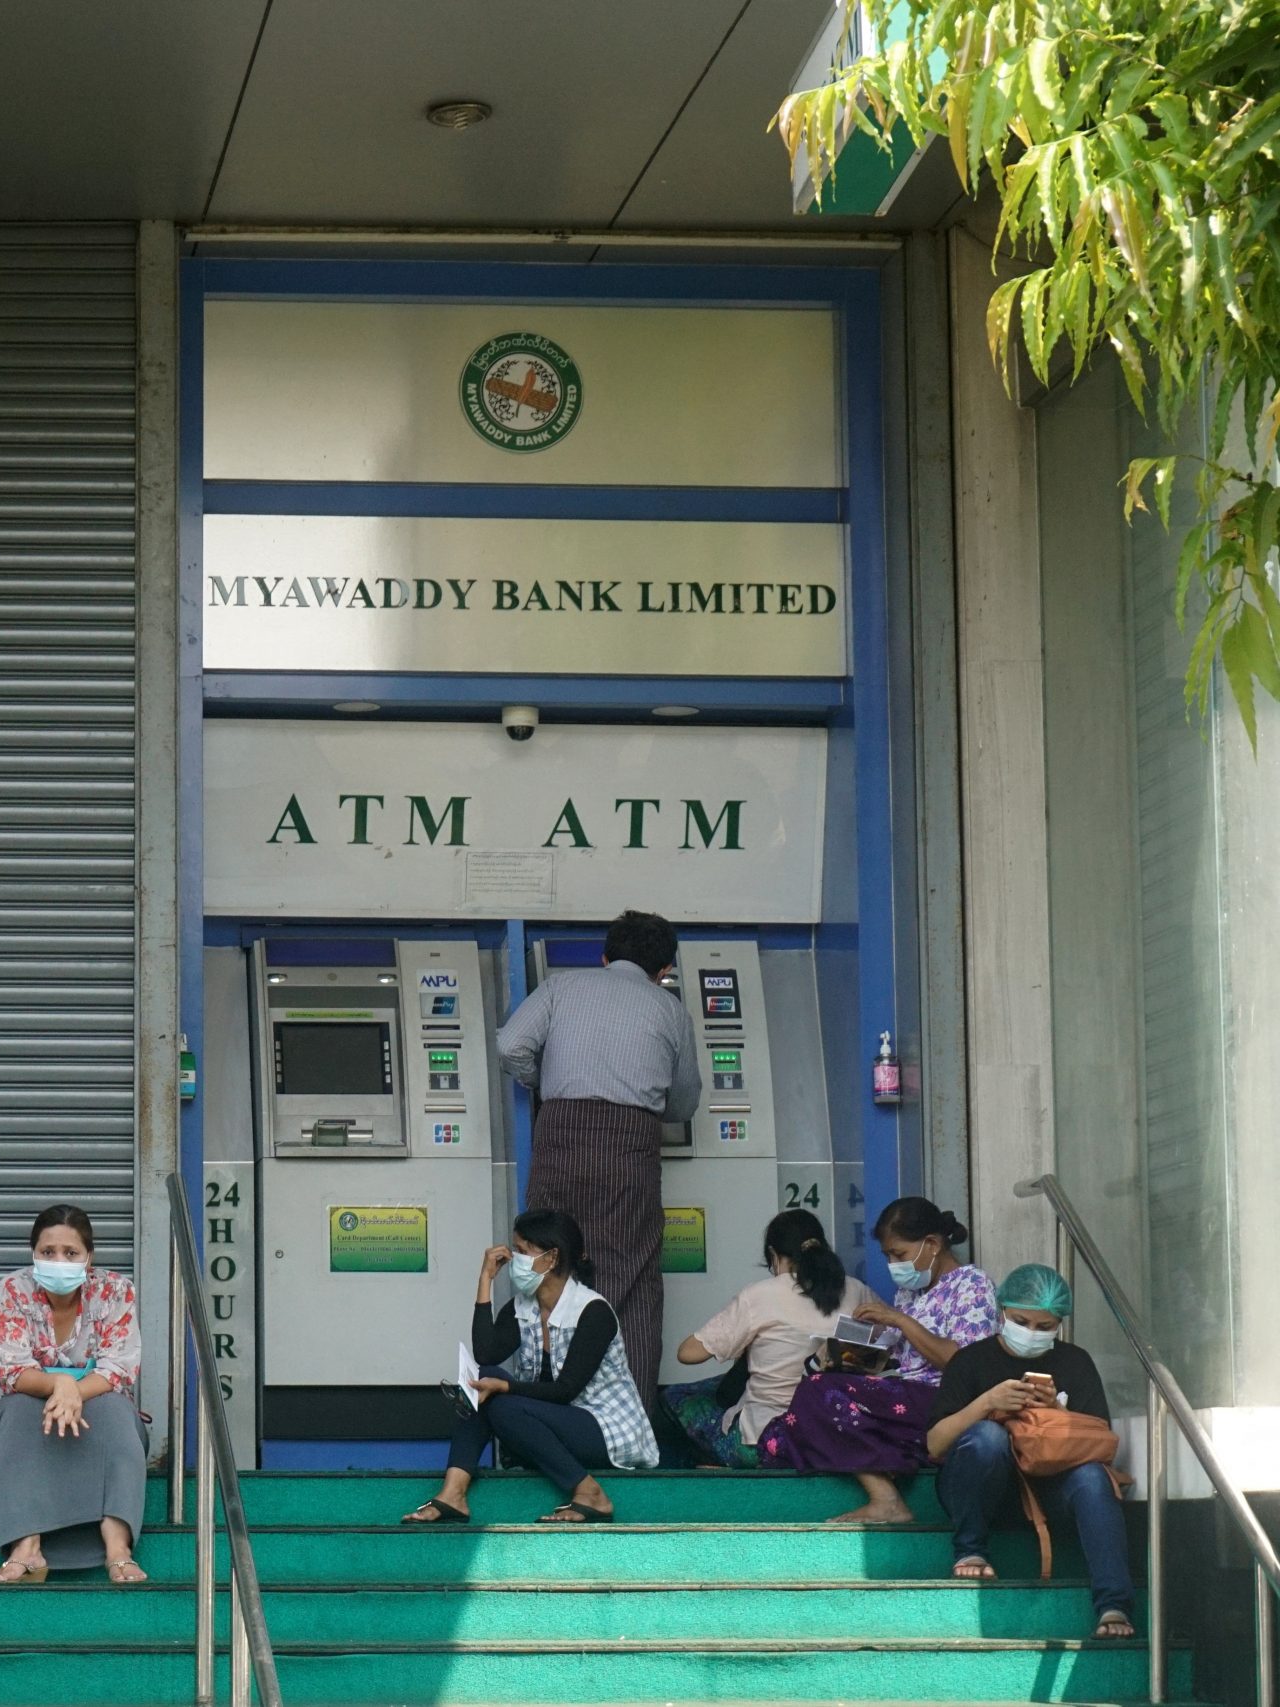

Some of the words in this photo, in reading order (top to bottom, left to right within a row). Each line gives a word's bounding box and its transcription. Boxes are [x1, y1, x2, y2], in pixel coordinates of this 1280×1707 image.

[466, 383, 512, 444] MYAWADDY
[516, 430, 552, 447] BANK
[552, 384, 578, 434] LIMITED
[207, 575, 478, 611] MYAWADDY
[491, 578, 624, 613] BANK
[636, 580, 837, 616] LIMITED
[265, 792, 473, 847] ATM
[540, 796, 748, 851] ATM
[420, 974, 457, 988] MPU
[706, 977, 732, 987] MPU
[205, 1182, 241, 1208] 24
[785, 1182, 820, 1208] 24
[208, 1218, 238, 1402] HOURS
